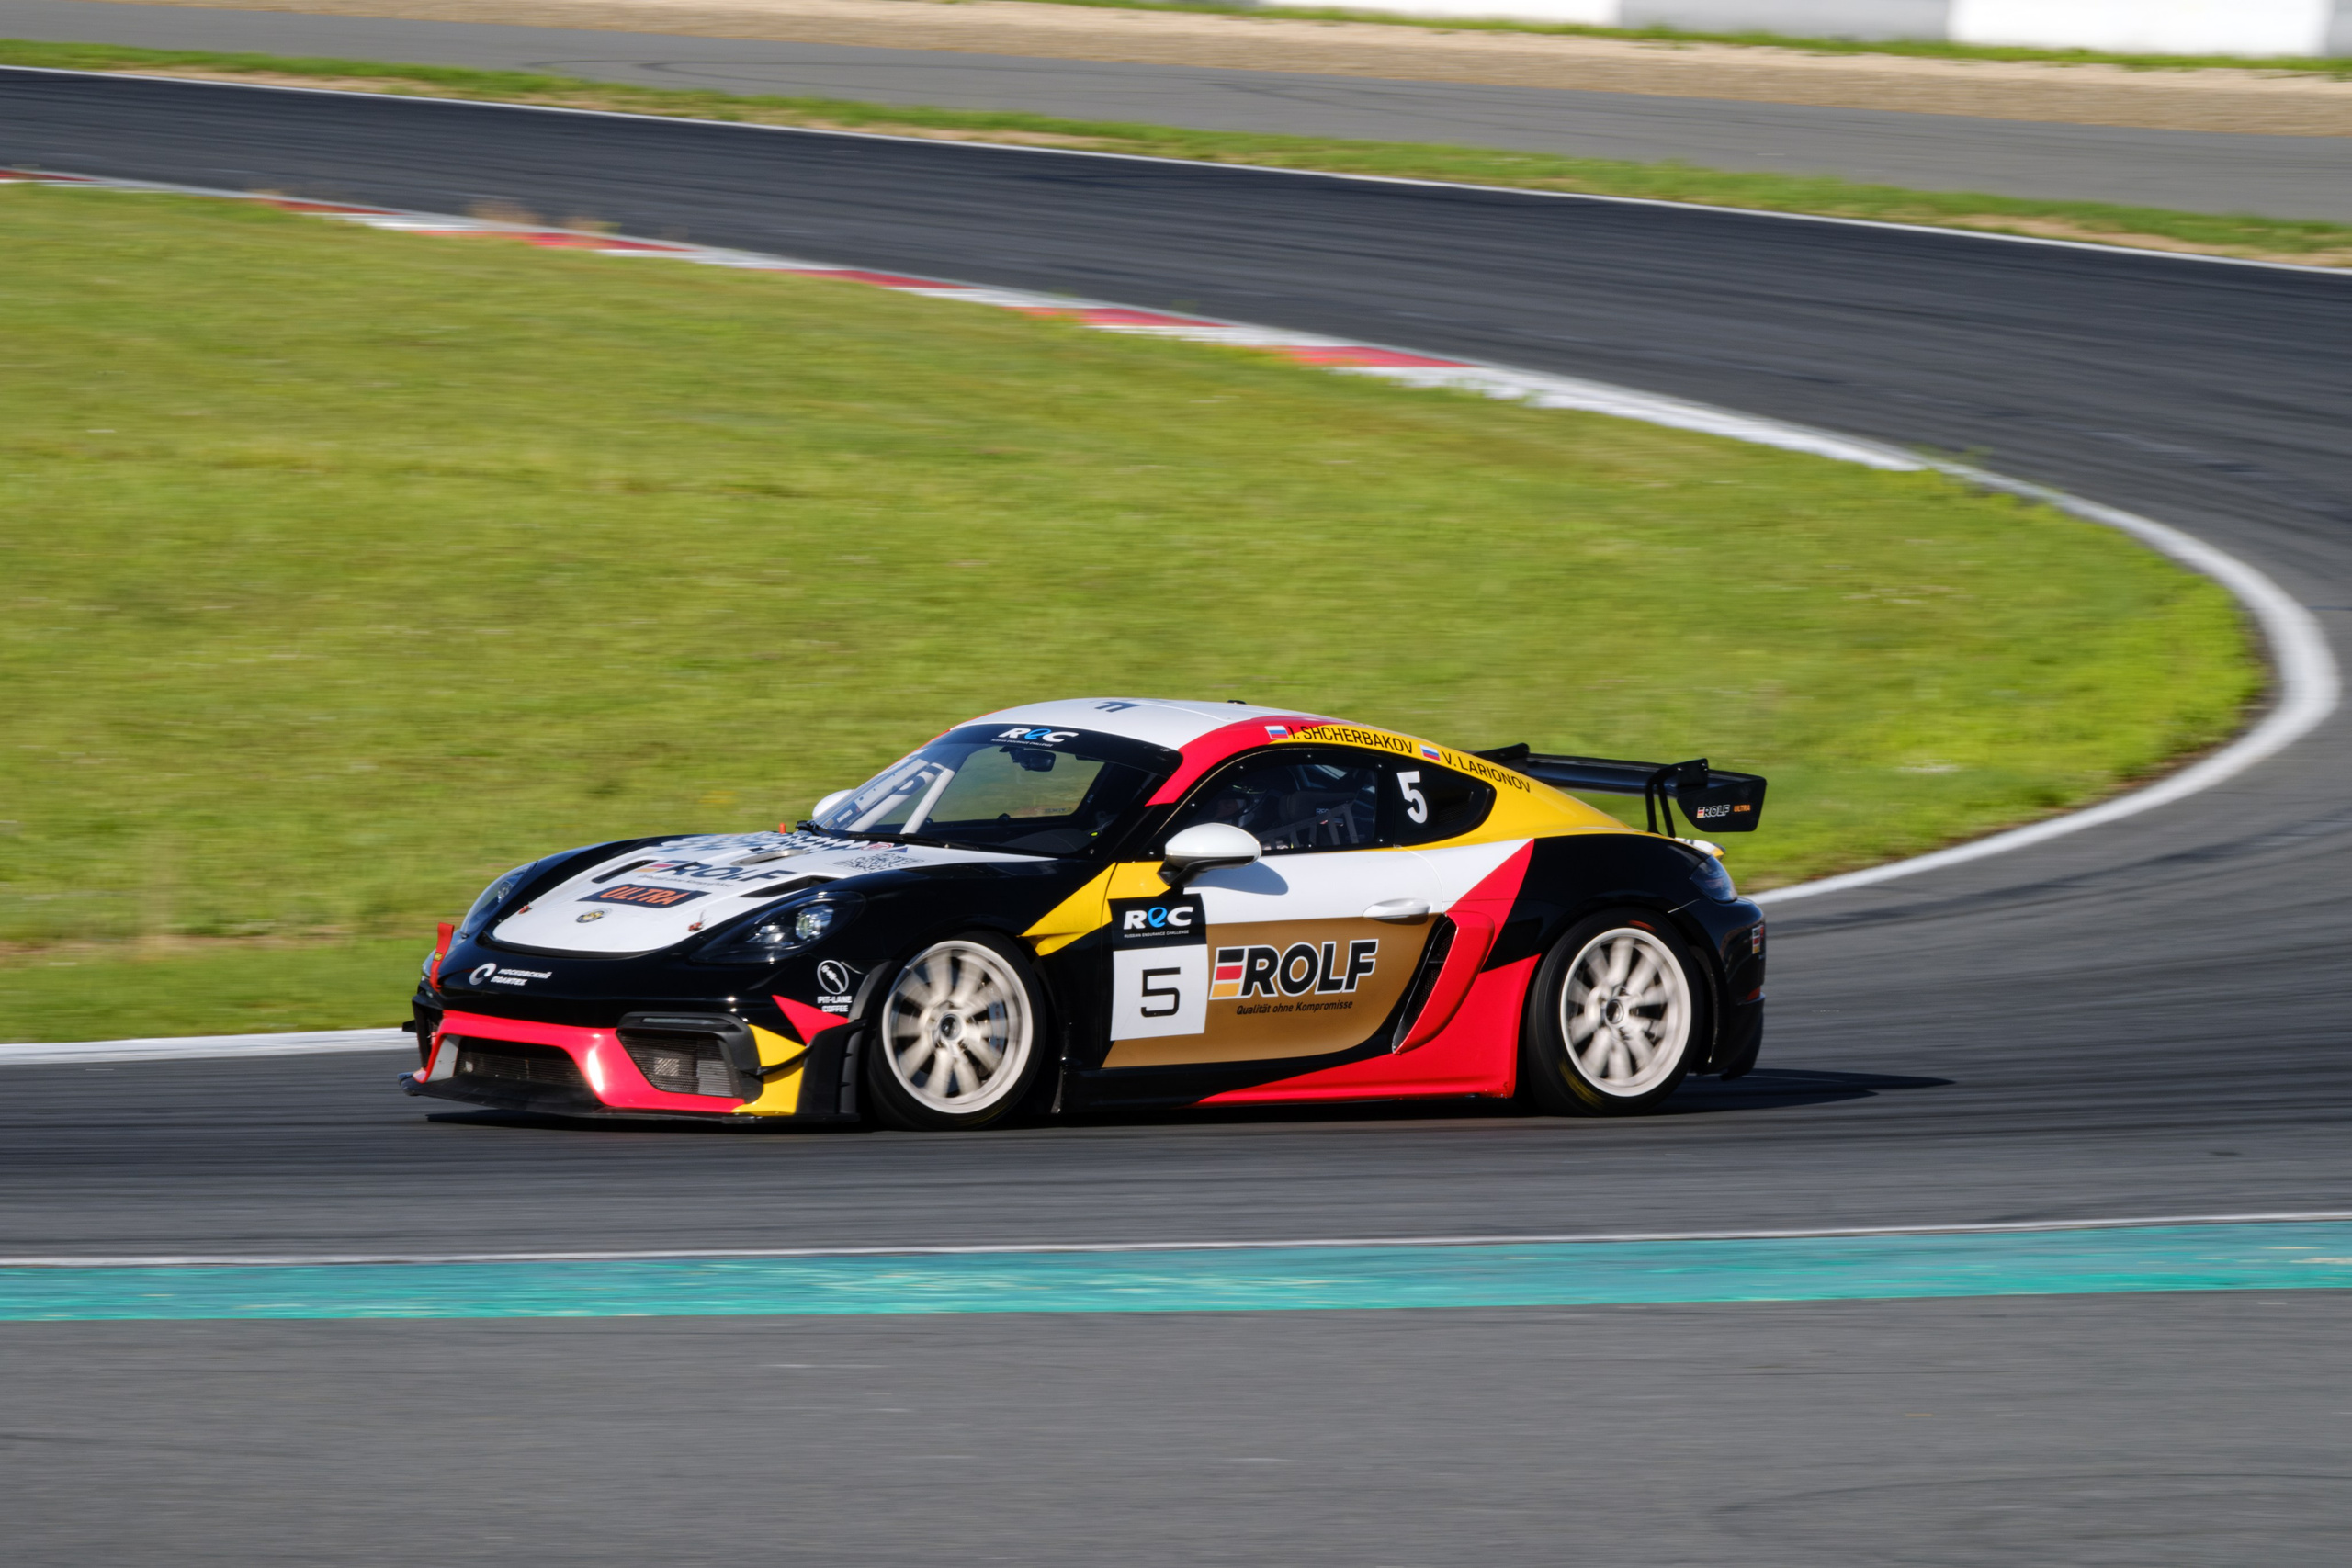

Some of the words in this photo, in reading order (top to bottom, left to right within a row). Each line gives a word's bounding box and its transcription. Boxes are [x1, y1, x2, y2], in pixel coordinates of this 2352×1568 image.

[1288, 726, 1300, 739] I.
[1300, 726, 1413, 754] SHCHERBAKOV
[1442, 750, 1457, 767] V.
[1458, 756, 1532, 794] LARIONOV
[1396, 771, 1428, 824] 5
[1702, 804, 1731, 818] ROLF
[599, 886, 692, 906] ULTRA
[1239, 938, 1379, 998] ROLF
[817, 995, 853, 1004] PIT-LANE
[1140, 966, 1182, 1019] 5
[821, 1004, 849, 1012] COFFEE
[1236, 1003, 1271, 1015] Qualität
[1272, 1002, 1295, 1013] ohne
[1295, 999, 1353, 1013] Kompromisse
